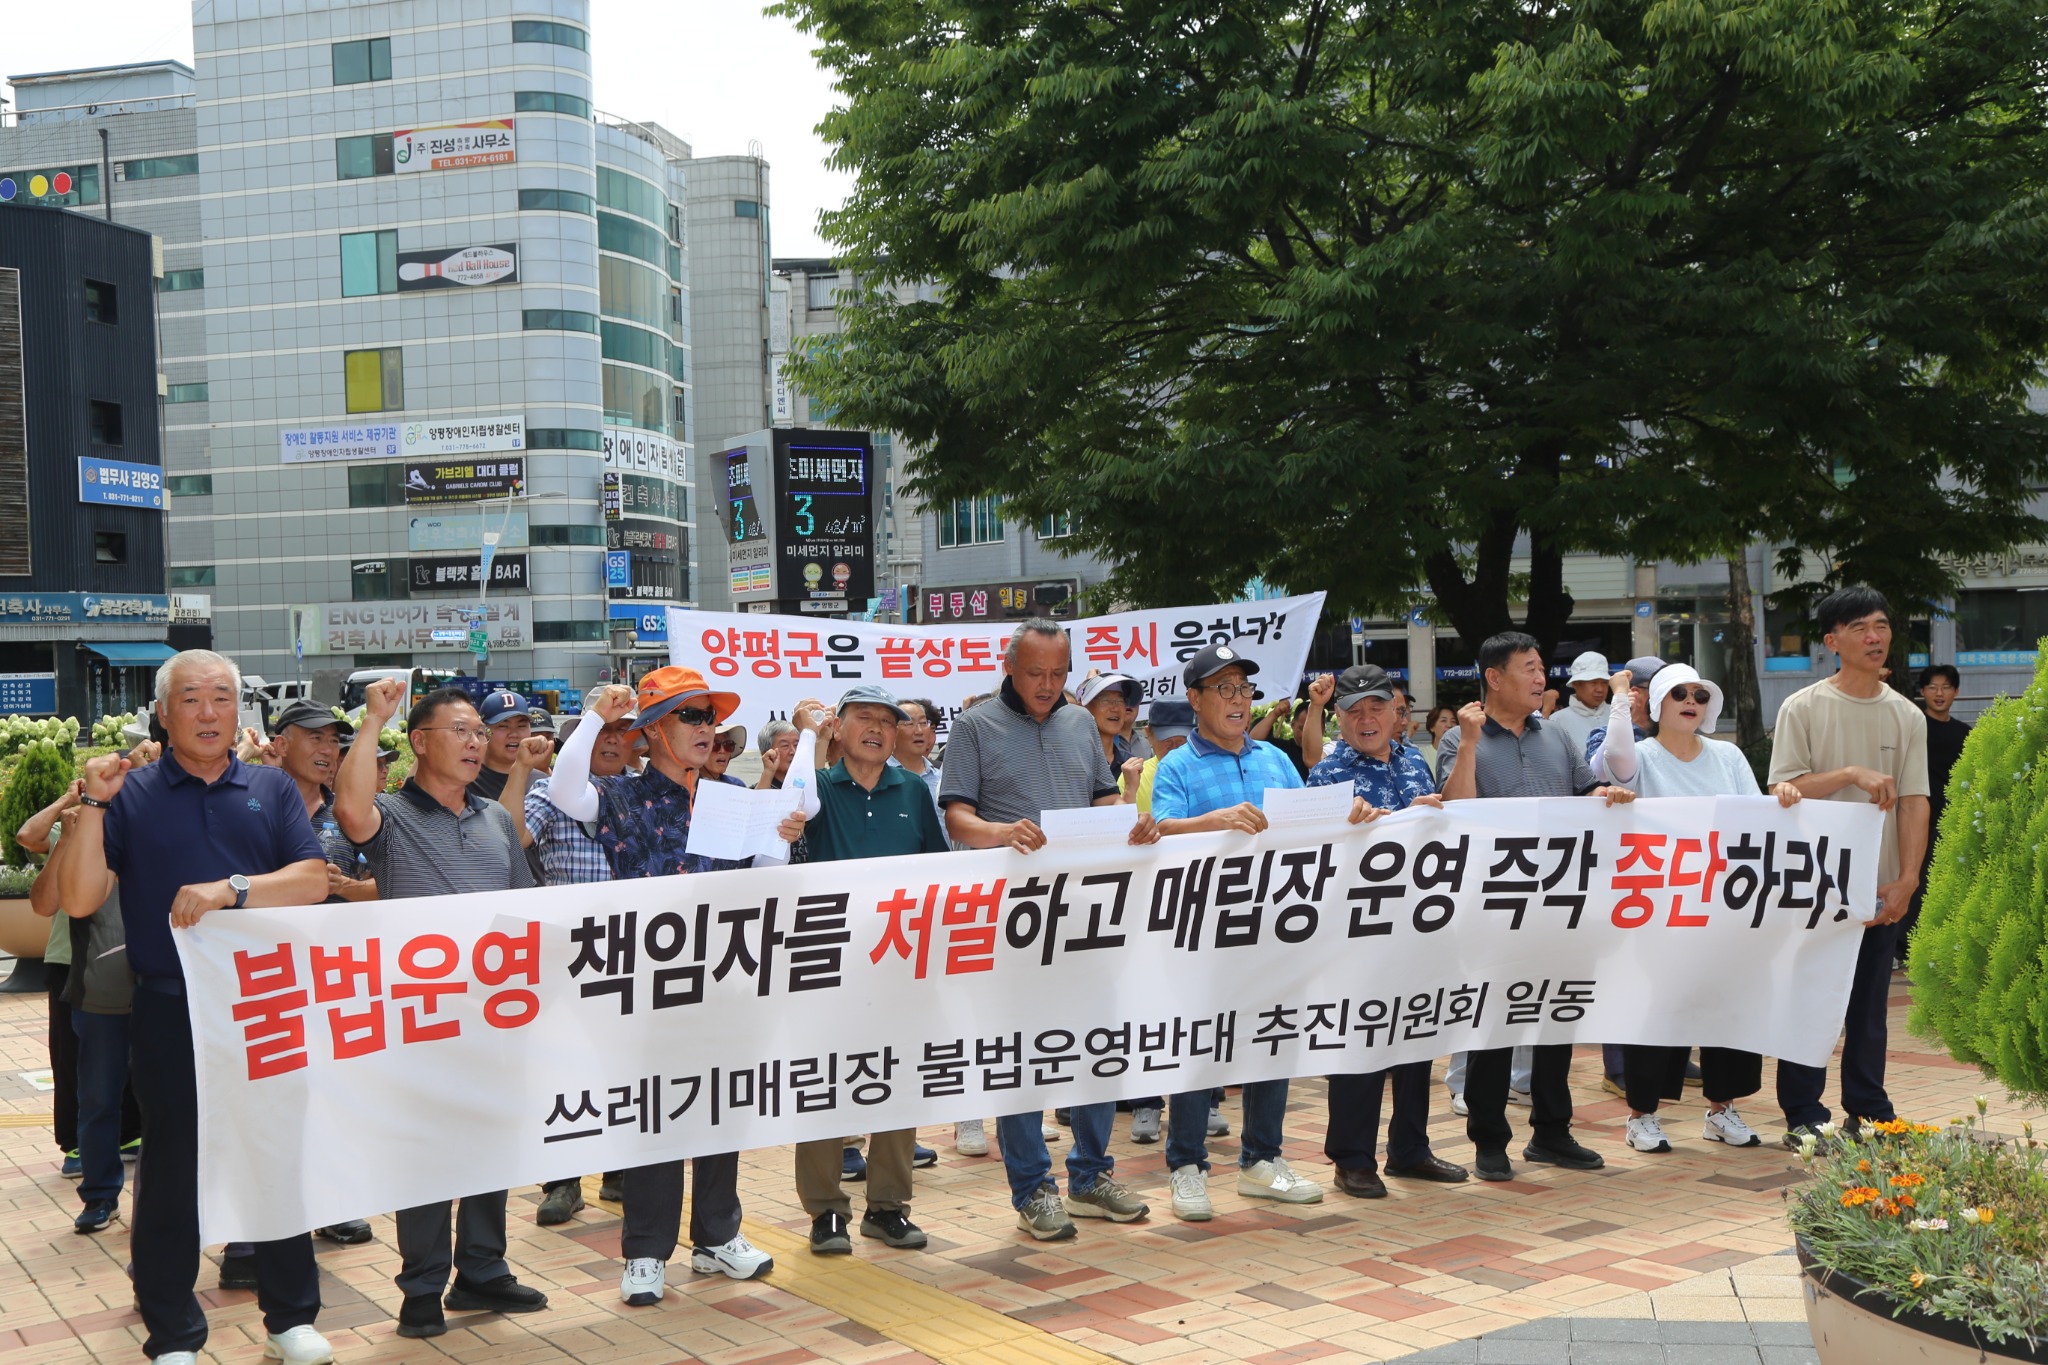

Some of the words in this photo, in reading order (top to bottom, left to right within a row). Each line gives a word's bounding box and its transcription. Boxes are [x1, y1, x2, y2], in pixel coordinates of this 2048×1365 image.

[430, 138, 455, 154] 진성
[472, 133, 510, 150] 사무소
[466, 260, 482, 272] Ball
[484, 259, 510, 270] House
[285, 432, 306, 446] 장애인
[310, 430, 339, 444] 활동지원
[342, 429, 364, 442] 서비스
[366, 427, 396, 441] 제공기관
[429, 422, 520, 440] 양평장애인자립생활센터
[100, 467, 129, 487] 법무사
[132, 471, 160, 490] 김영오
[436, 466, 474, 480] 가브리엘
[476, 464, 496, 478] 대대
[499, 463, 518, 476] 클럽
[794, 494, 814, 536] 3
[786, 544, 830, 557] 미세먼지
[833, 544, 864, 557] 알리미
[608, 556, 624, 568] GS
[436, 566, 468, 582] 블랙캣
[496, 564, 520, 579] BAR
[610, 568, 624, 580] 25
[44, 605, 71, 614] 사무소
[930, 590, 988, 618] 부동산
[328, 607, 374, 625] ENG
[380, 605, 428, 624] 인허가
[642, 614, 667, 632] GS25
[328, 630, 386, 651] 건축사
[504, 628, 518, 637] 2F
[702, 628, 864, 678] 양평군은
[1084, 622, 1158, 670] 즉시
[502, 694, 515, 708] D
[232, 920, 541, 1080] 불법운영
[567, 892, 852, 1016] 책임자를
[868, 870, 1132, 980] 처벌하고
[1148, 844, 1337, 952] 매립장
[1347, 834, 1470, 938] 운영
[1481, 830, 1598, 930] 즉각
[1610, 830, 1852, 930] 중단하라!
[544, 1045, 899, 1144] 쓰레기매립장
[916, 1010, 1236, 1099] 불법운영반대
[1252, 981, 1490, 1056] 추진위원회
[1505, 979, 1597, 1026] 일동
